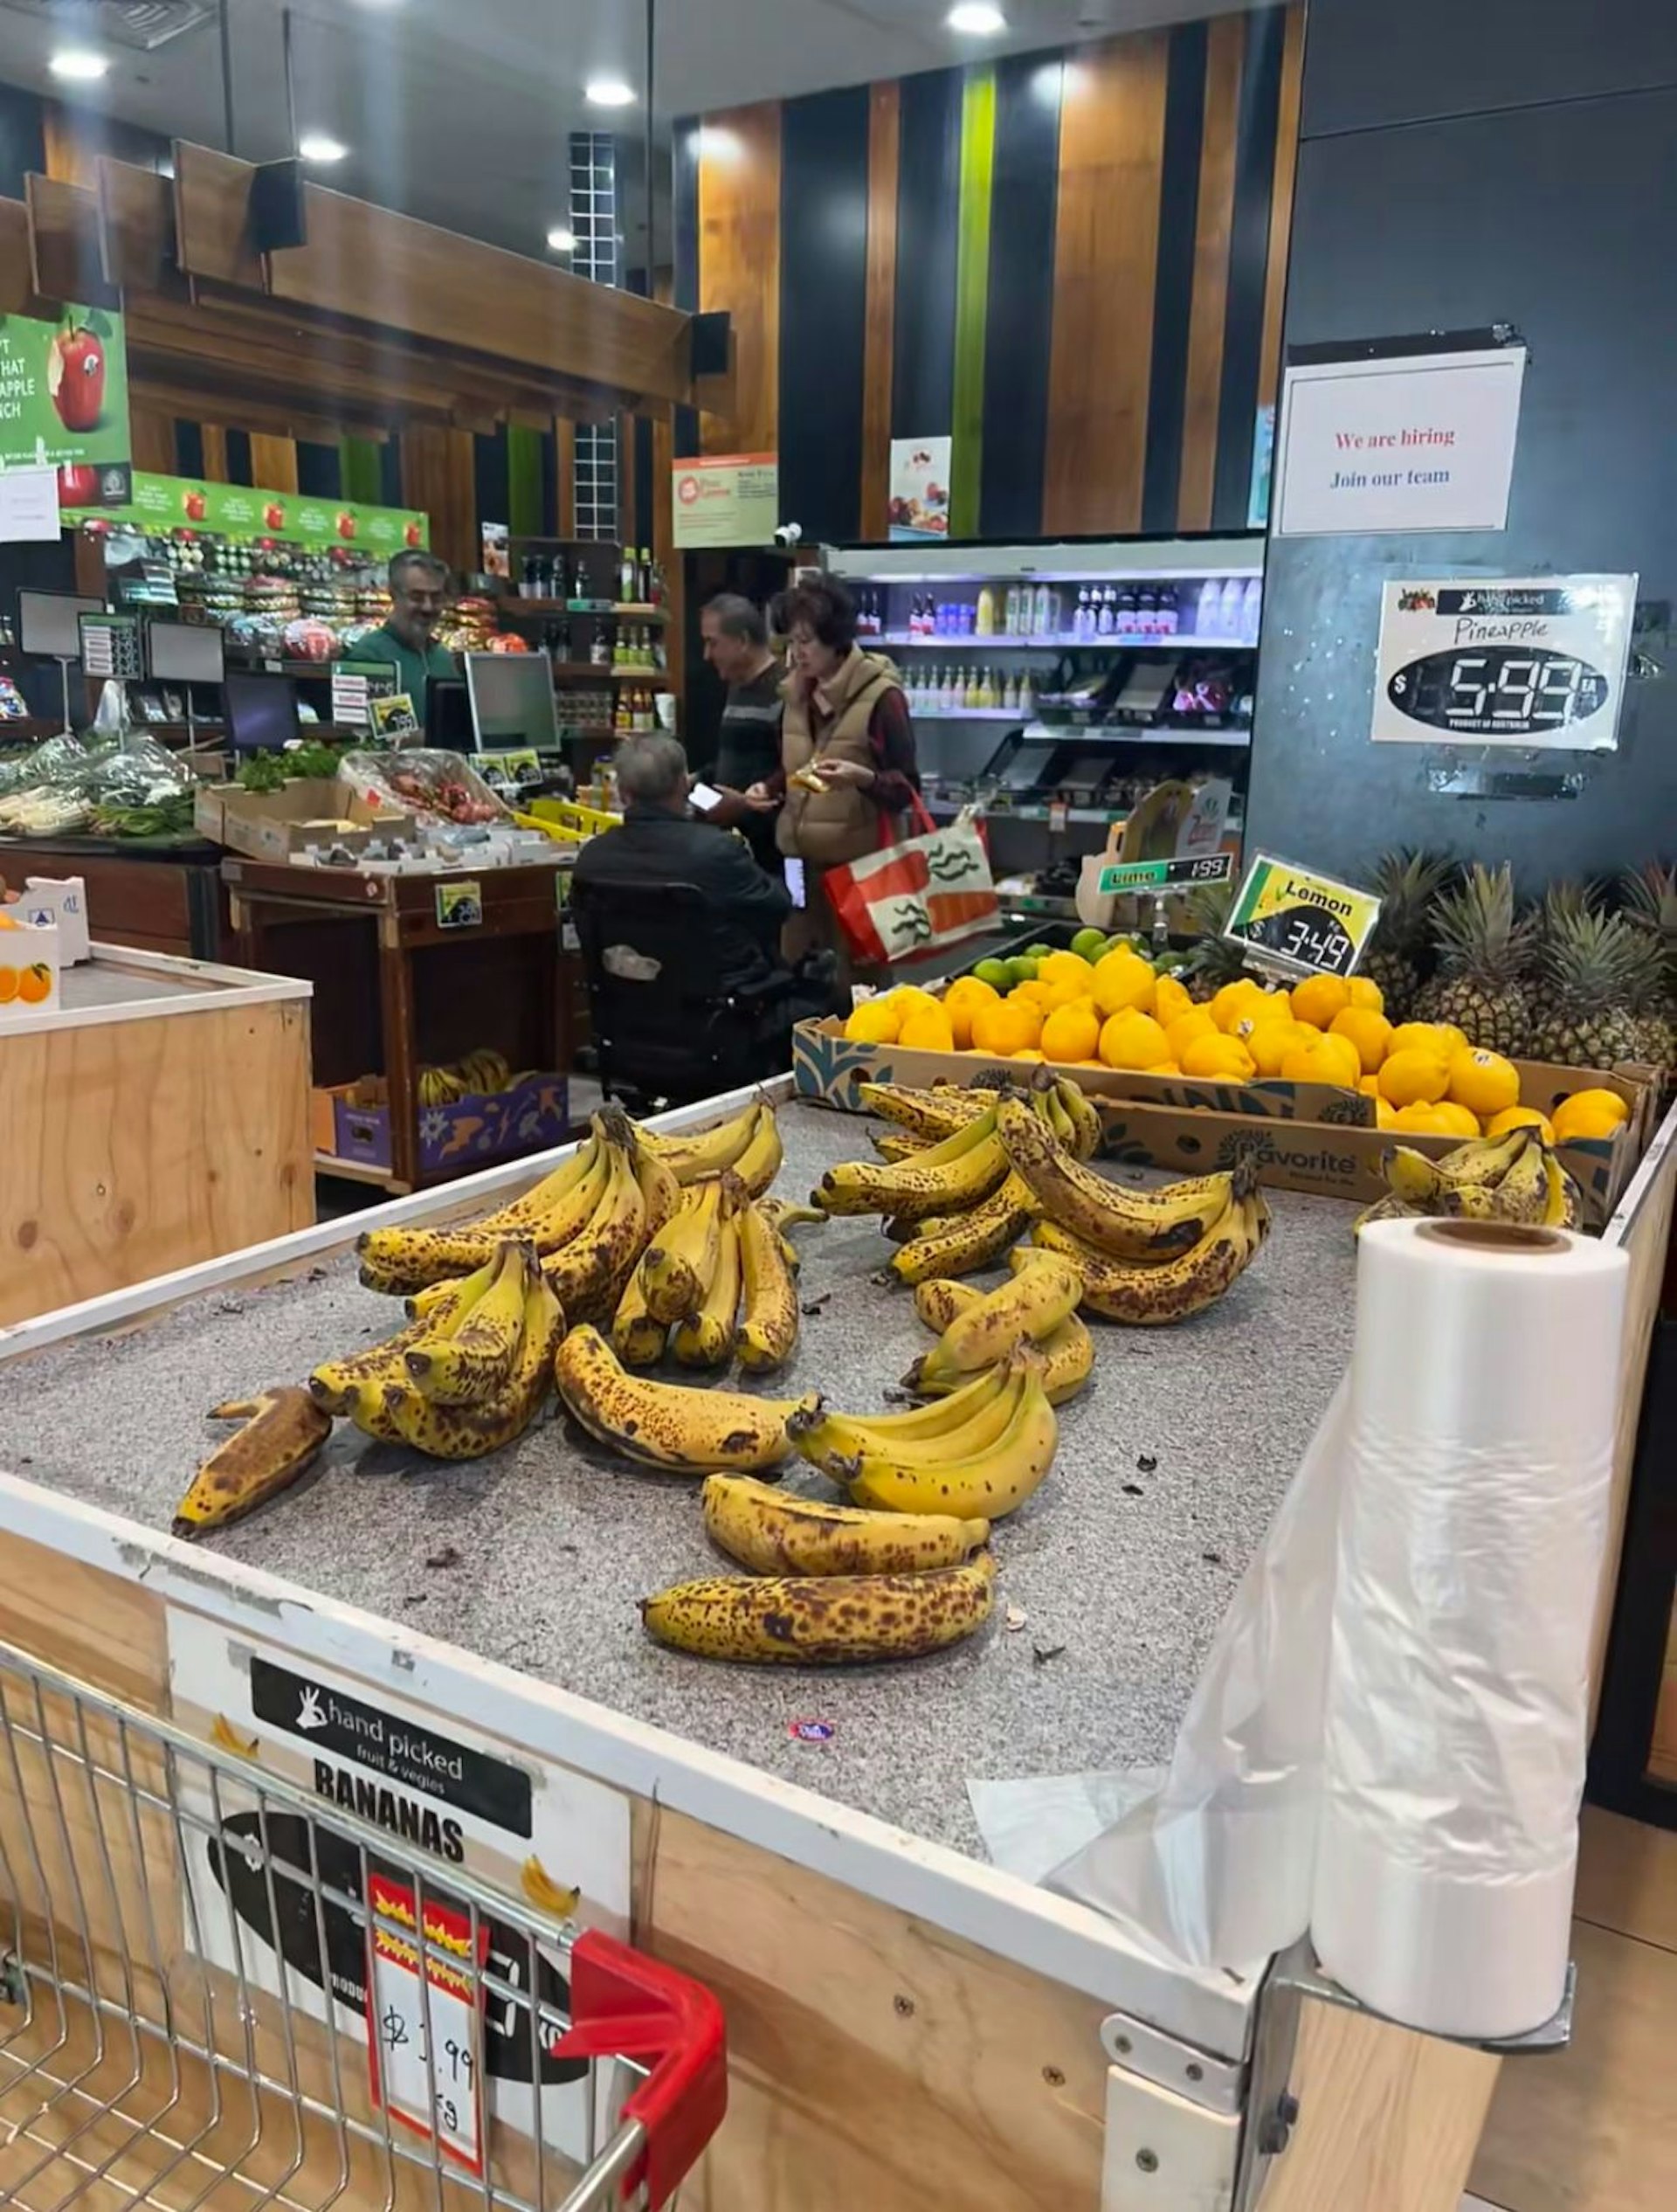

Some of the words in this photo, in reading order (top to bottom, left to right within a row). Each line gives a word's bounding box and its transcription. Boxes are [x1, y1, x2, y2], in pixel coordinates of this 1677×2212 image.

[1335, 432, 1364, 450] We
[1368, 433, 1397, 448] are
[1401, 427, 1456, 447] hiring
[1329, 471, 1368, 489] Join
[1372, 472, 1403, 487] our
[1406, 469, 1451, 485] team
[1446, 659, 1583, 725] 5.99
[1112, 871, 1156, 885] Lime
[1285, 881, 1353, 916] Lemon
[1280, 920, 1349, 971] 3.49
[328, 1697, 384, 1743] hand
[390, 1733, 463, 1781] picked
[356, 1744, 386, 1769] fruit
[387, 1758, 399, 1774] &
[400, 1766, 445, 1795] vegies
[314, 1758, 464, 1863] BANANAS
